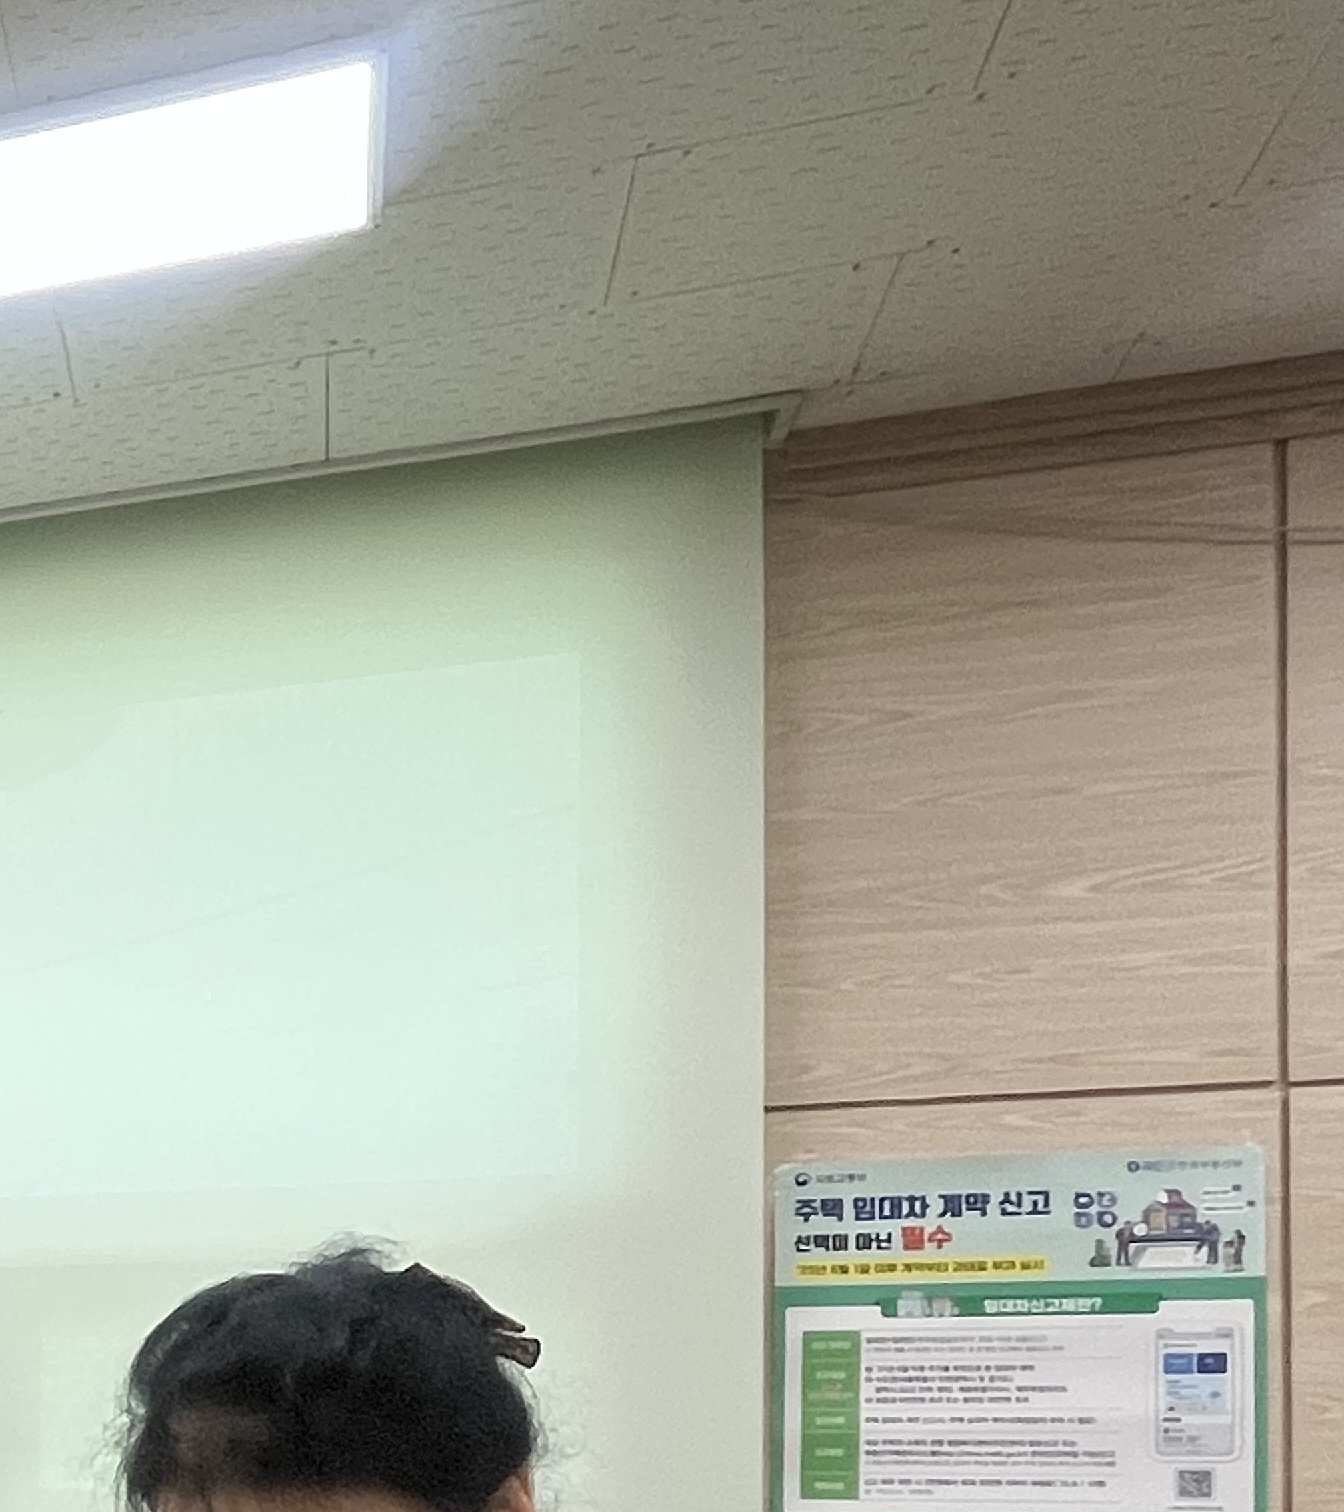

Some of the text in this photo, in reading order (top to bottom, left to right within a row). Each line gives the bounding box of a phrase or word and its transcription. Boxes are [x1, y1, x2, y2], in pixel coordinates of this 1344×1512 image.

[794, 1190, 1052, 1222] 주택 임대차 계약 신고
[855, 1231, 893, 1251] 아닌
[901, 1224, 953, 1251] 필수
